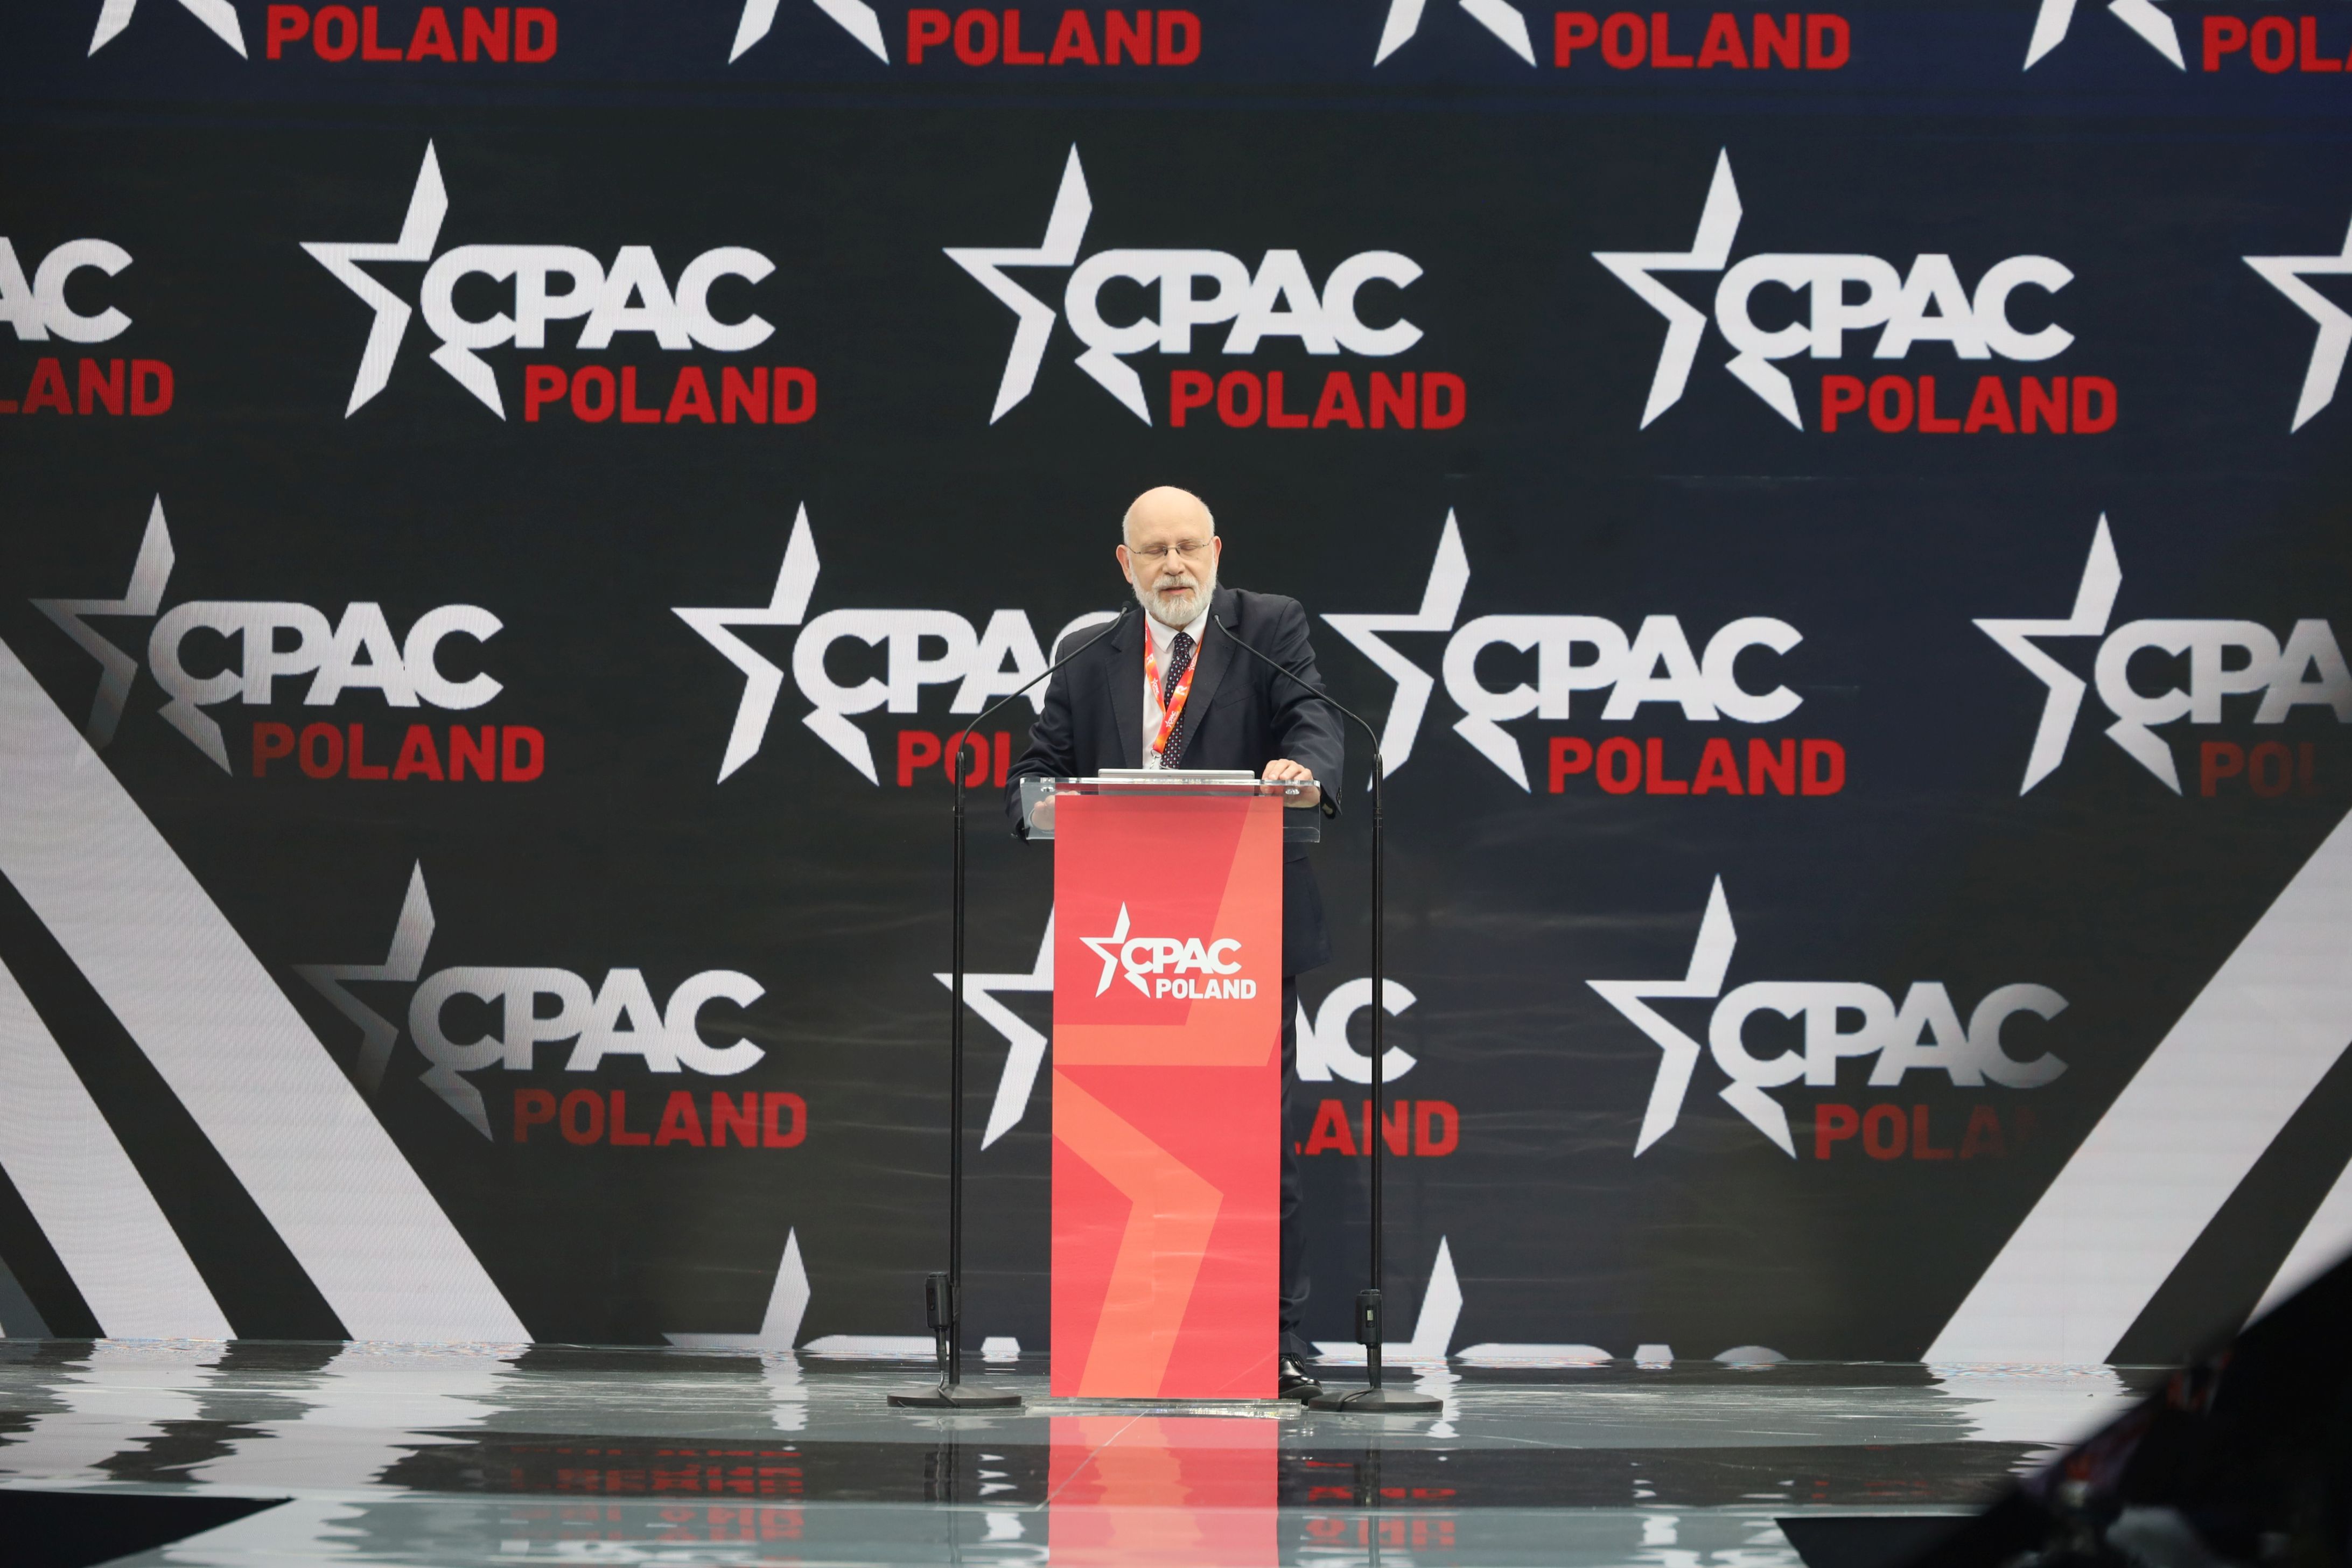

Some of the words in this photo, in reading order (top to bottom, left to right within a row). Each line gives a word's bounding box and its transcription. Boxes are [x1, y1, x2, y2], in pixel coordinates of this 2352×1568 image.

[266, 4, 558, 62] POLAND
[907, 9, 1201, 66] POLAND
[1554, 12, 1851, 69] POLAND
[2202, 16, 2352, 74] POL
[421, 244, 776, 352] CPAC
[1065, 249, 1424, 356] CPAC
[1714, 253, 2075, 361] CPAC
[524, 365, 817, 424] POLAND
[1170, 370, 1467, 430] POLAND
[1821, 375, 2118, 434] POLAND
[148, 600, 505, 710] CPAC
[1442, 614, 1804, 723] CPAC
[252, 723, 545, 782] POLAND
[1548, 736, 1846, 796] POLAND
[1121, 937, 1242, 975] CPAC
[1156, 978, 1257, 999] POLAND
[408, 966, 766, 1076] CPAC
[1709, 981, 2069, 1089] CPAC
[514, 1089, 808, 1149] POLAND
[1294, 1098, 1460, 1157] AND
